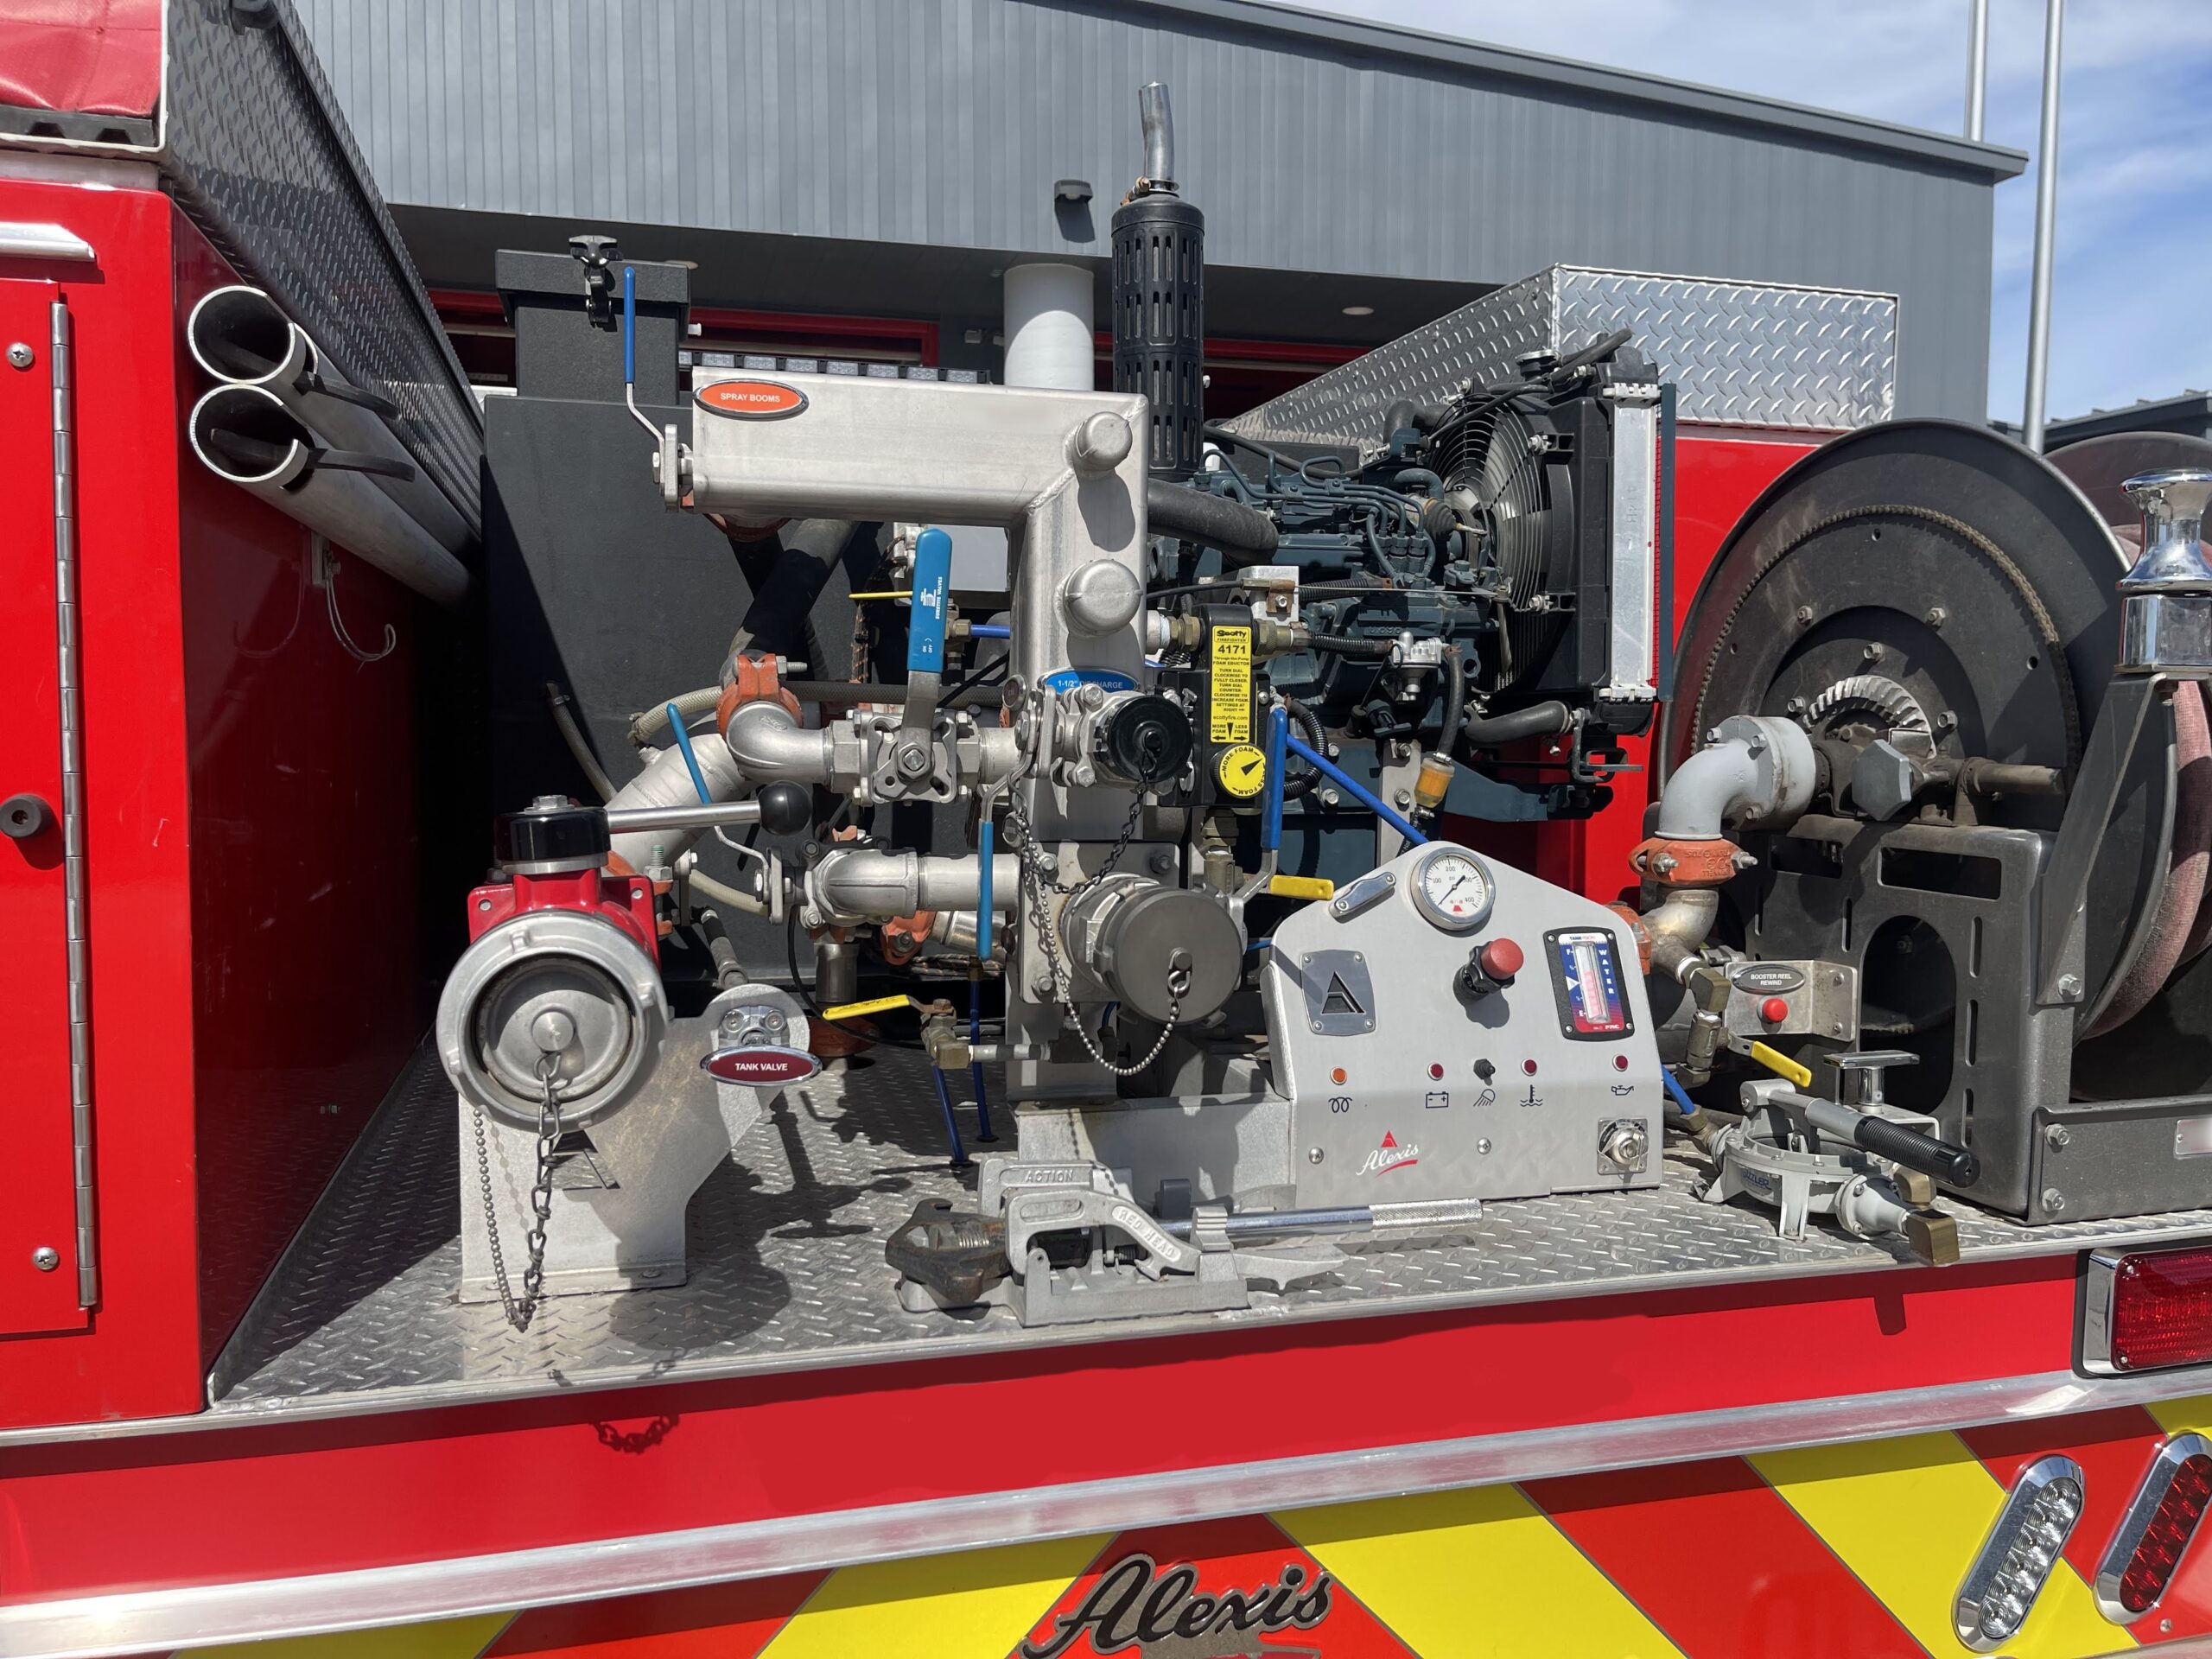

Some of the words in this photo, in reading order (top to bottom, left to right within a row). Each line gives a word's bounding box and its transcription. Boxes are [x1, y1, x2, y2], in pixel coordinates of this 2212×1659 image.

[720, 392, 748, 401] SPRAY
[750, 394, 781, 403] BOOMS
[1217, 629, 1247, 639] Scotty
[1217, 645, 1246, 654] 4171
[1222, 752, 1234, 772] MORE
[1238, 786, 1258, 795] FOAM
[1599, 949, 1615, 995] WATER
[734, 1063, 759, 1071] TANK
[760, 1063, 788, 1071] VALVE
[1356, 1143, 1419, 1176] Alexis
[1025, 1169, 1074, 1183] ACTION
[1119, 1209, 1143, 1232] RED
[1143, 1226, 1176, 1258] HEAD
[1021, 1558, 1332, 1659] Alexis
